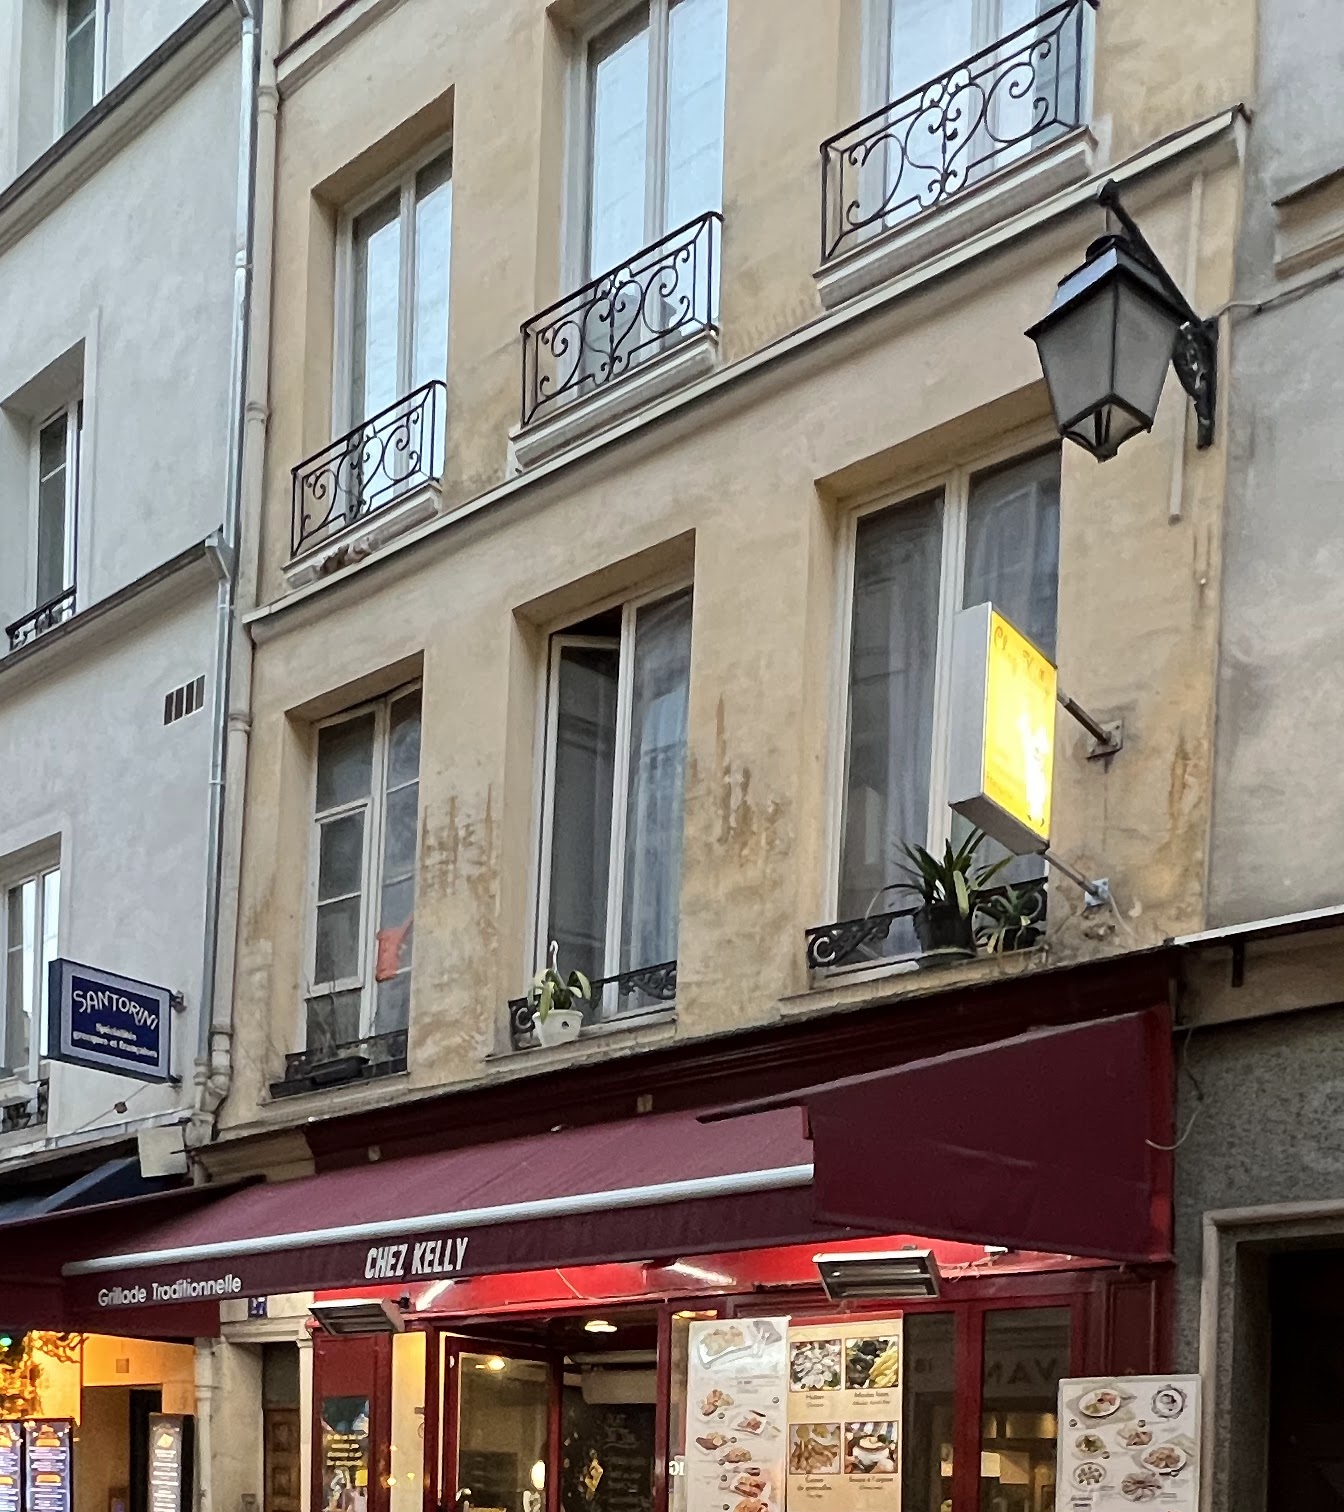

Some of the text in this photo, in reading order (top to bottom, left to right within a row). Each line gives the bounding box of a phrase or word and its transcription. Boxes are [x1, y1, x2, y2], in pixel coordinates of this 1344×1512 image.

[72, 990, 159, 1030] SANTORINI
[364, 1237, 469, 1279] CHEZ KELLY
[98, 1273, 243, 1307] Grillade Traditionnelle
